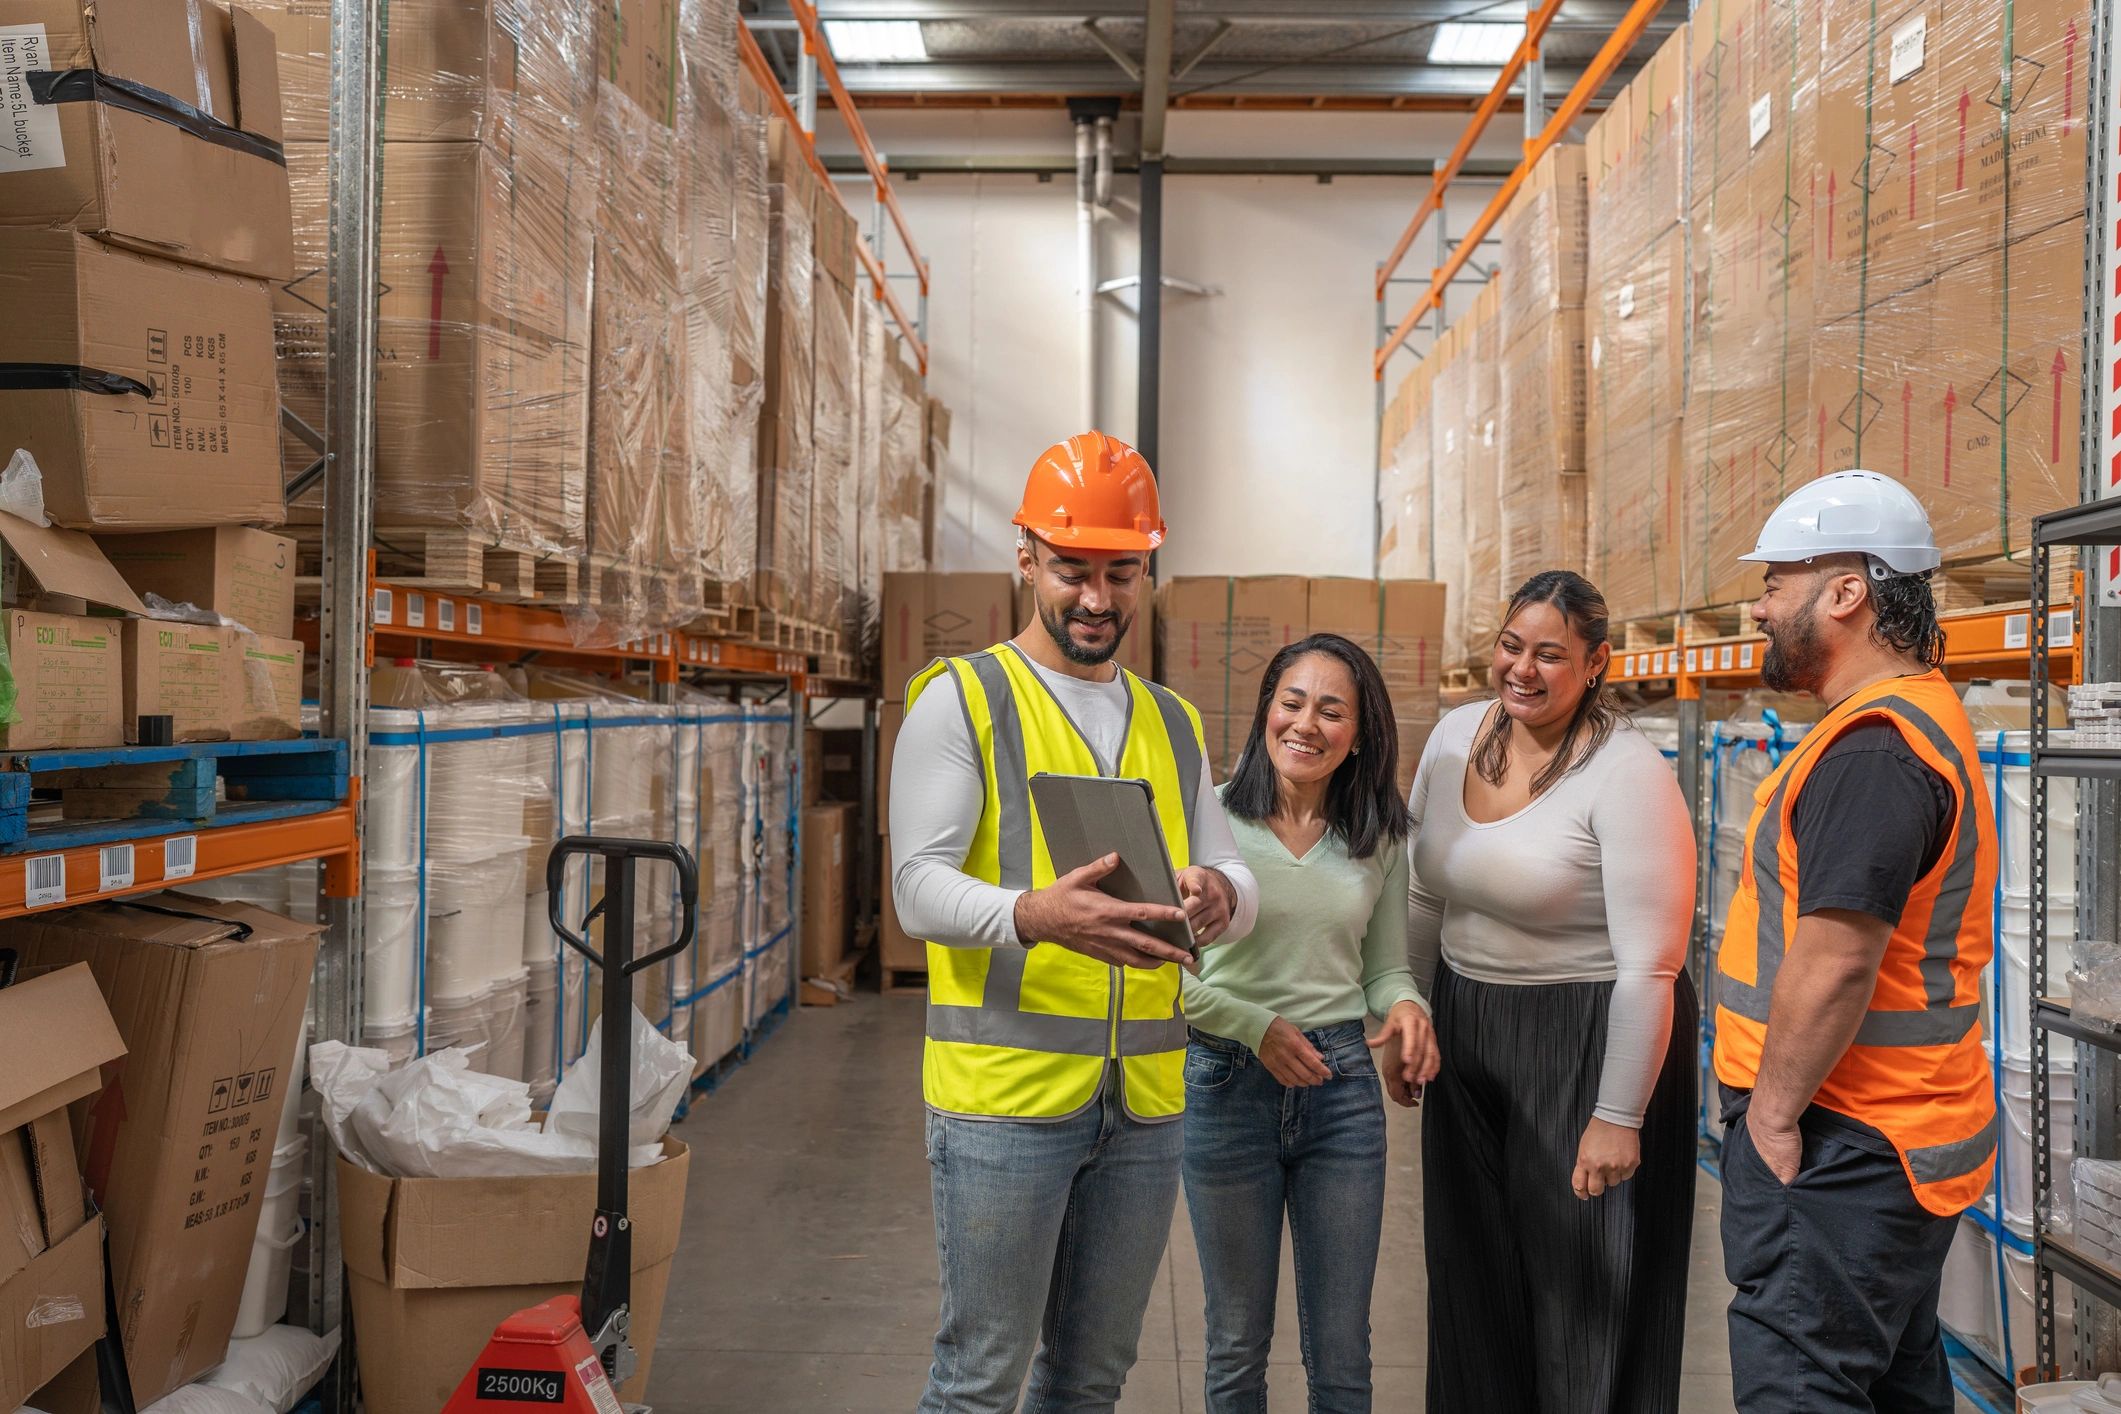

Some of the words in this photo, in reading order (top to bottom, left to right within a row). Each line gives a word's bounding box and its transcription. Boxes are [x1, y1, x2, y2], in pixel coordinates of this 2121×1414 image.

[20, 36, 38, 66] Ryan
[2, 38, 16, 64] Item
[14, 119, 33, 158] bucket
[2018, 125, 2047, 149] CHINA
[184, 335, 192, 357] PCS
[196, 336, 204, 358] KGS
[208, 337, 216, 359] KGS
[219, 333, 226, 349] CM
[172, 364, 180, 399] 50009
[184, 377, 192, 395] 100
[172, 402, 181, 423] NO.:
[174, 425, 182, 450] ITEM
[186, 427, 194, 451] QTY:
[209, 427, 218, 452] G.W.:
[220, 422, 229, 454] MEAS:
[203, 1119, 219, 1136] ITEM
[249, 1128, 261, 1143] PCS
[245, 1149, 257, 1165] KGS
[240, 1171, 253, 1187] KGS
[484, 1375, 558, 1399] 2500Kg
